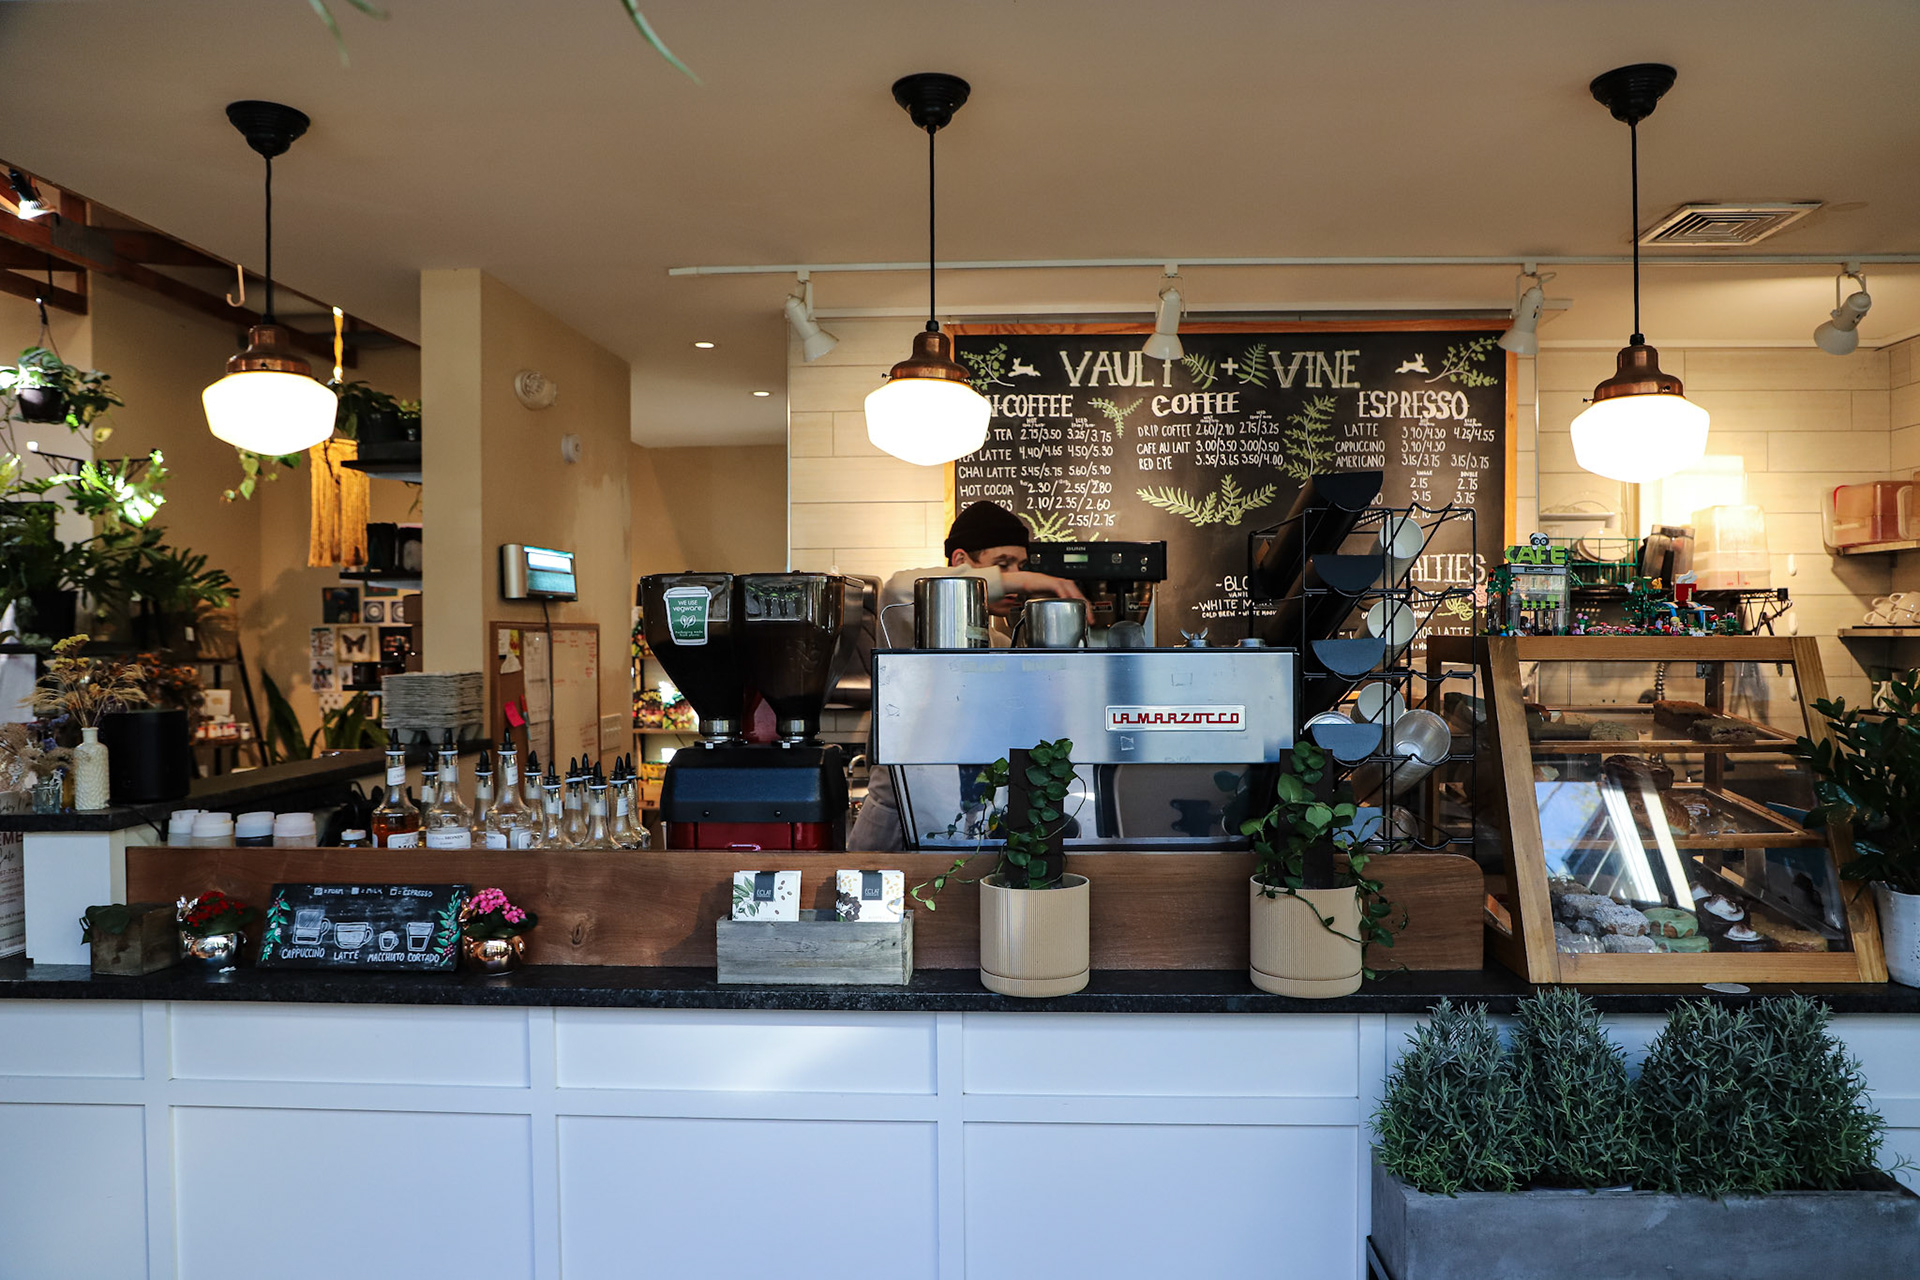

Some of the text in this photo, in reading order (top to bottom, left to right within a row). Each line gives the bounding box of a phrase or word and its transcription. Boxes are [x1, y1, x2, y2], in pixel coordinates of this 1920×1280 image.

[1268, 350, 1361, 388] VINE
[984, 394, 1074, 418] N-COFFEE
[1151, 391, 1240, 417] COFFEE
[1357, 390, 1470, 420] ESPRESSO
[994, 428, 1013, 441] TEA
[1137, 424, 1159, 437] DRIP
[1161, 423, 1192, 437] COFFEE
[1344, 423, 1379, 437] LATTE
[1136, 442, 1157, 455] CAFE
[1159, 442, 1170, 454] AU
[1172, 441, 1191, 454] LAIT
[1335, 440, 1386, 453] CAPPUCCINO
[958, 453, 975, 463] EA
[979, 449, 1012, 461] LATTE
[1138, 457, 1154, 470] RED
[1156, 455, 1173, 470] EYE
[1335, 454, 1386, 468] AMERICANO
[958, 466, 984, 479] CHAI
[986, 466, 1018, 478] LATTE
[959, 484, 982, 497] HOT
[984, 484, 1015, 496] COCOA
[1504, 545, 1566, 565] CAFE
[1409, 553, 1486, 584] ALTIES
[281, 948, 325, 959] CAPPUCCINO
[334, 950, 359, 960] LATTE
[407, 952, 440, 963] CORTADO
